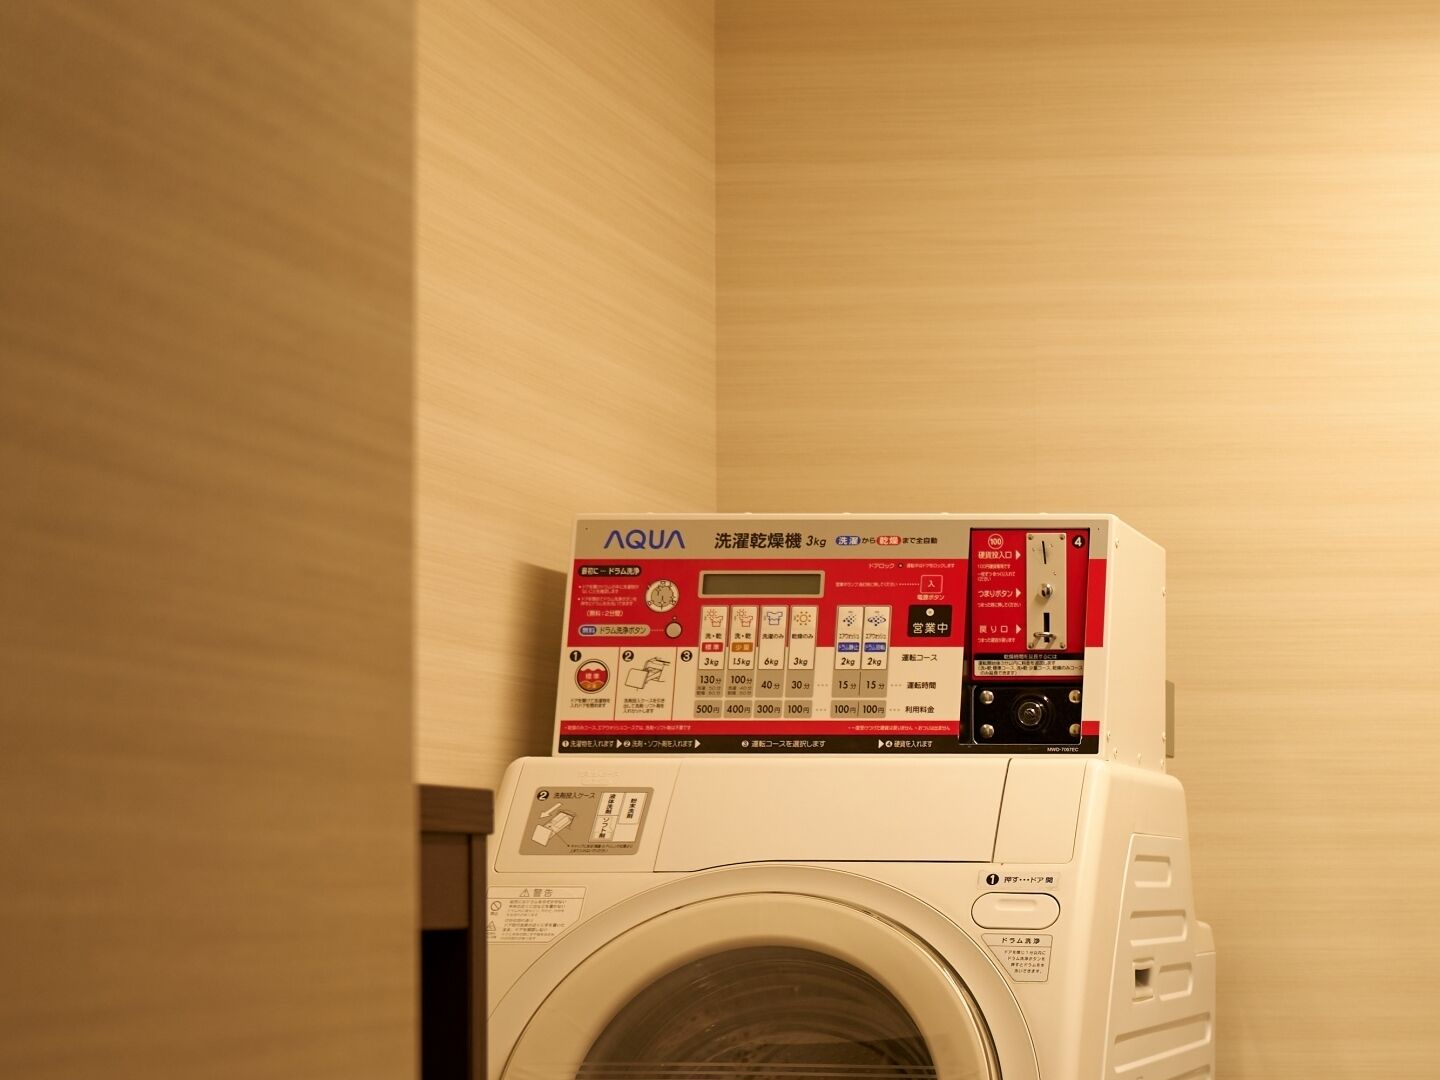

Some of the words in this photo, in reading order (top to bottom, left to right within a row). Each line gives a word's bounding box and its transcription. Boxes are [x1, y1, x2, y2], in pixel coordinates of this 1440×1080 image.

[604, 530, 685, 549] AQUA
[714, 532, 802, 548] 洗濯乾燥機
[806, 536, 826, 548] 3kg
[913, 623, 948, 633] 営業中
[696, 705, 719, 713] 500円
[727, 705, 750, 713] 400円
[757, 705, 780, 713] 300円
[788, 705, 809, 713] 100円
[835, 705, 856, 713] 100円
[863, 705, 884, 713] 100円
[751, 740, 826, 748] 運転コースを選択します
